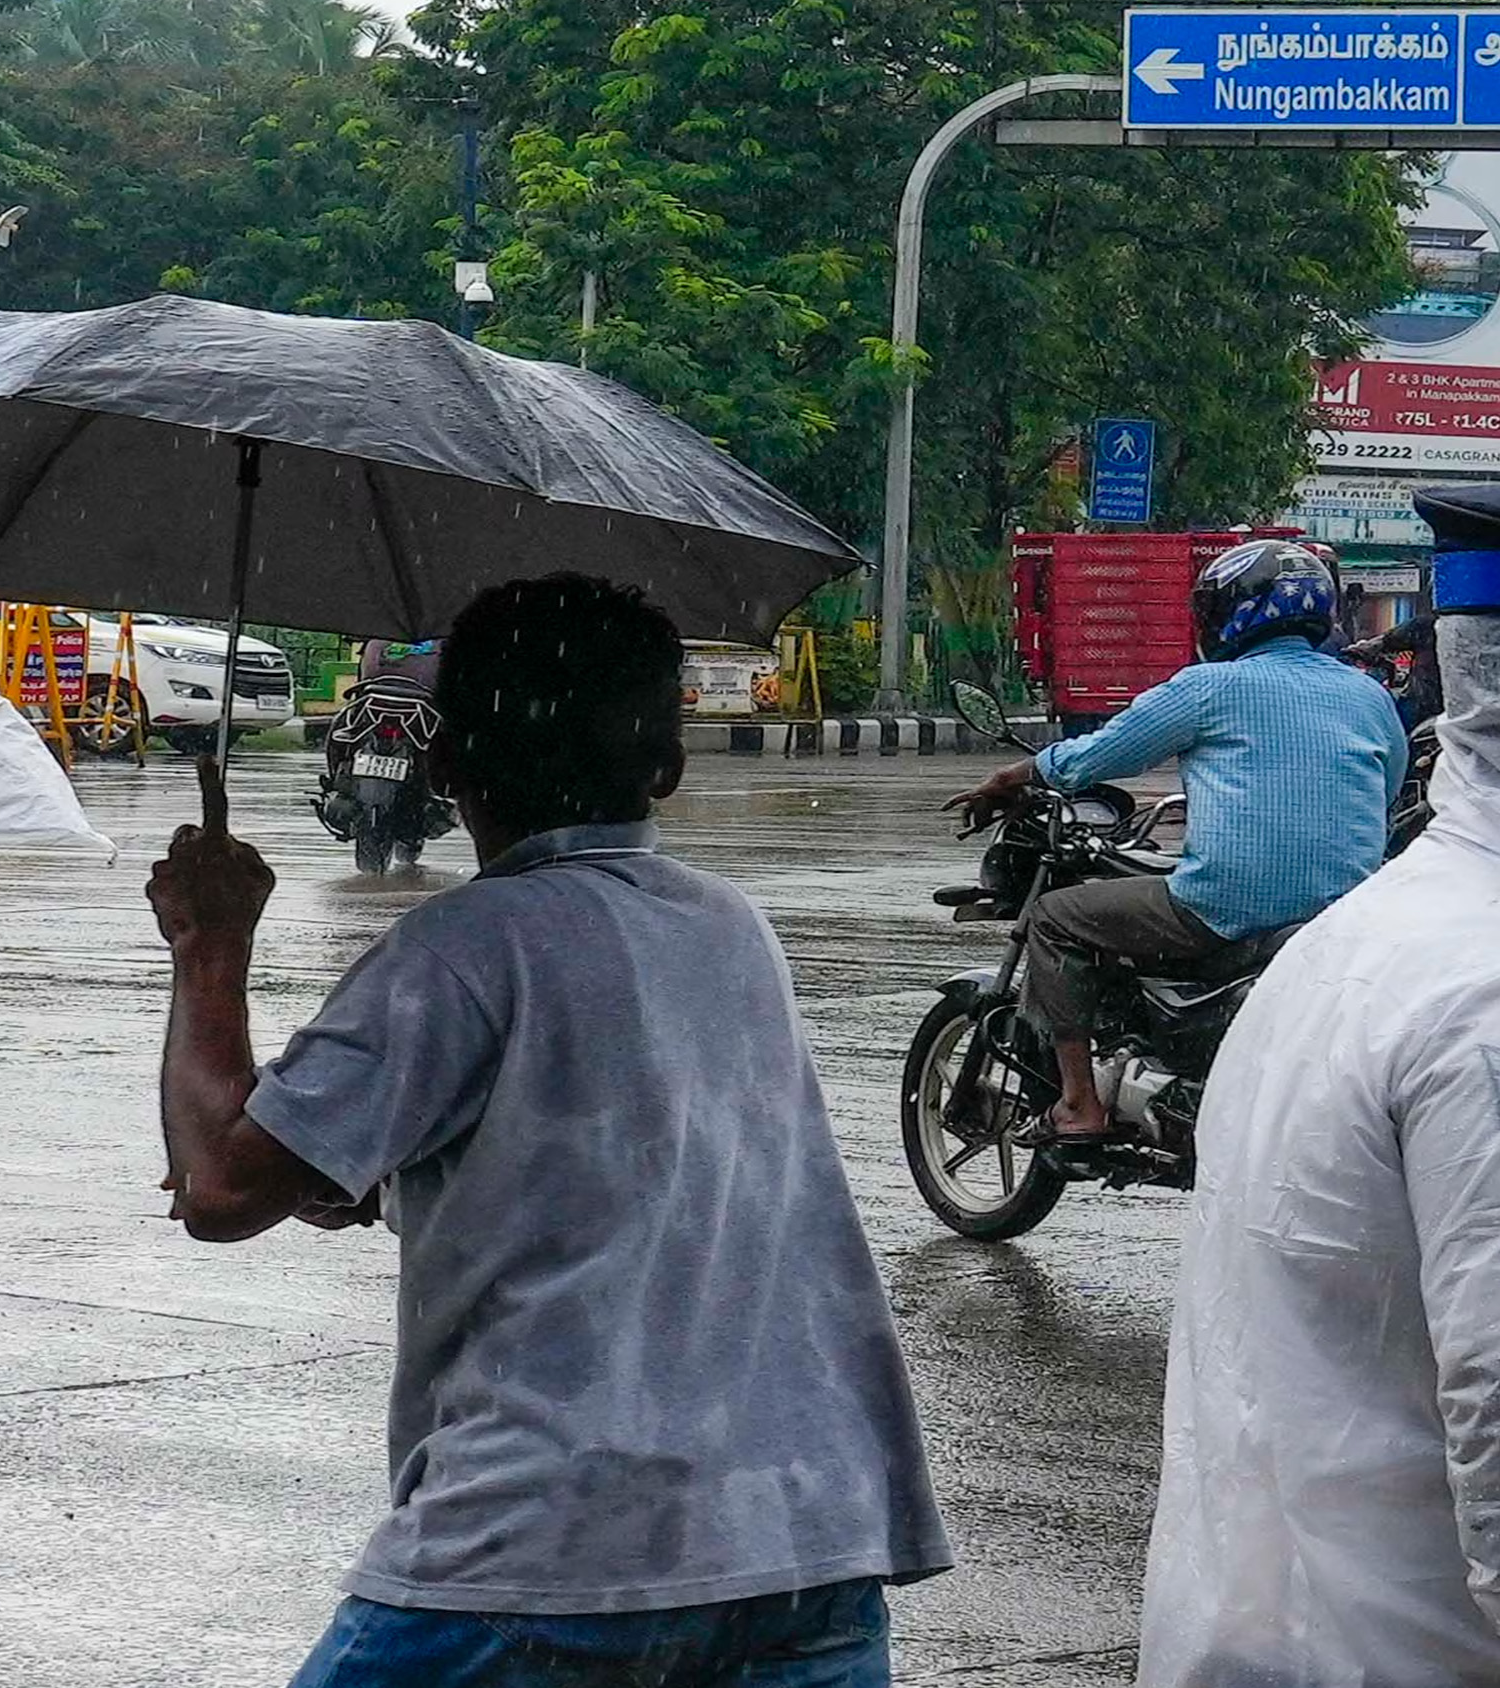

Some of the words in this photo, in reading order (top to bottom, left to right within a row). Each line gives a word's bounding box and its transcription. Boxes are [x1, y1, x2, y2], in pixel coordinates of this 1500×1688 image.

[1216, 22, 1449, 72] நுங்கம்பாக்கம்
[1215, 78, 1449, 119] Nungambakkam
[1387, 373, 1395, 384] 2
[1411, 375, 1419, 385] 3
[1422, 376, 1450, 386] BHK
[1406, 390, 1417, 399] in
[1420, 390, 1500, 404] Manapakkam
[1355, 446, 1413, 460] 22222
[1192, 546, 1235, 556] POLIC
